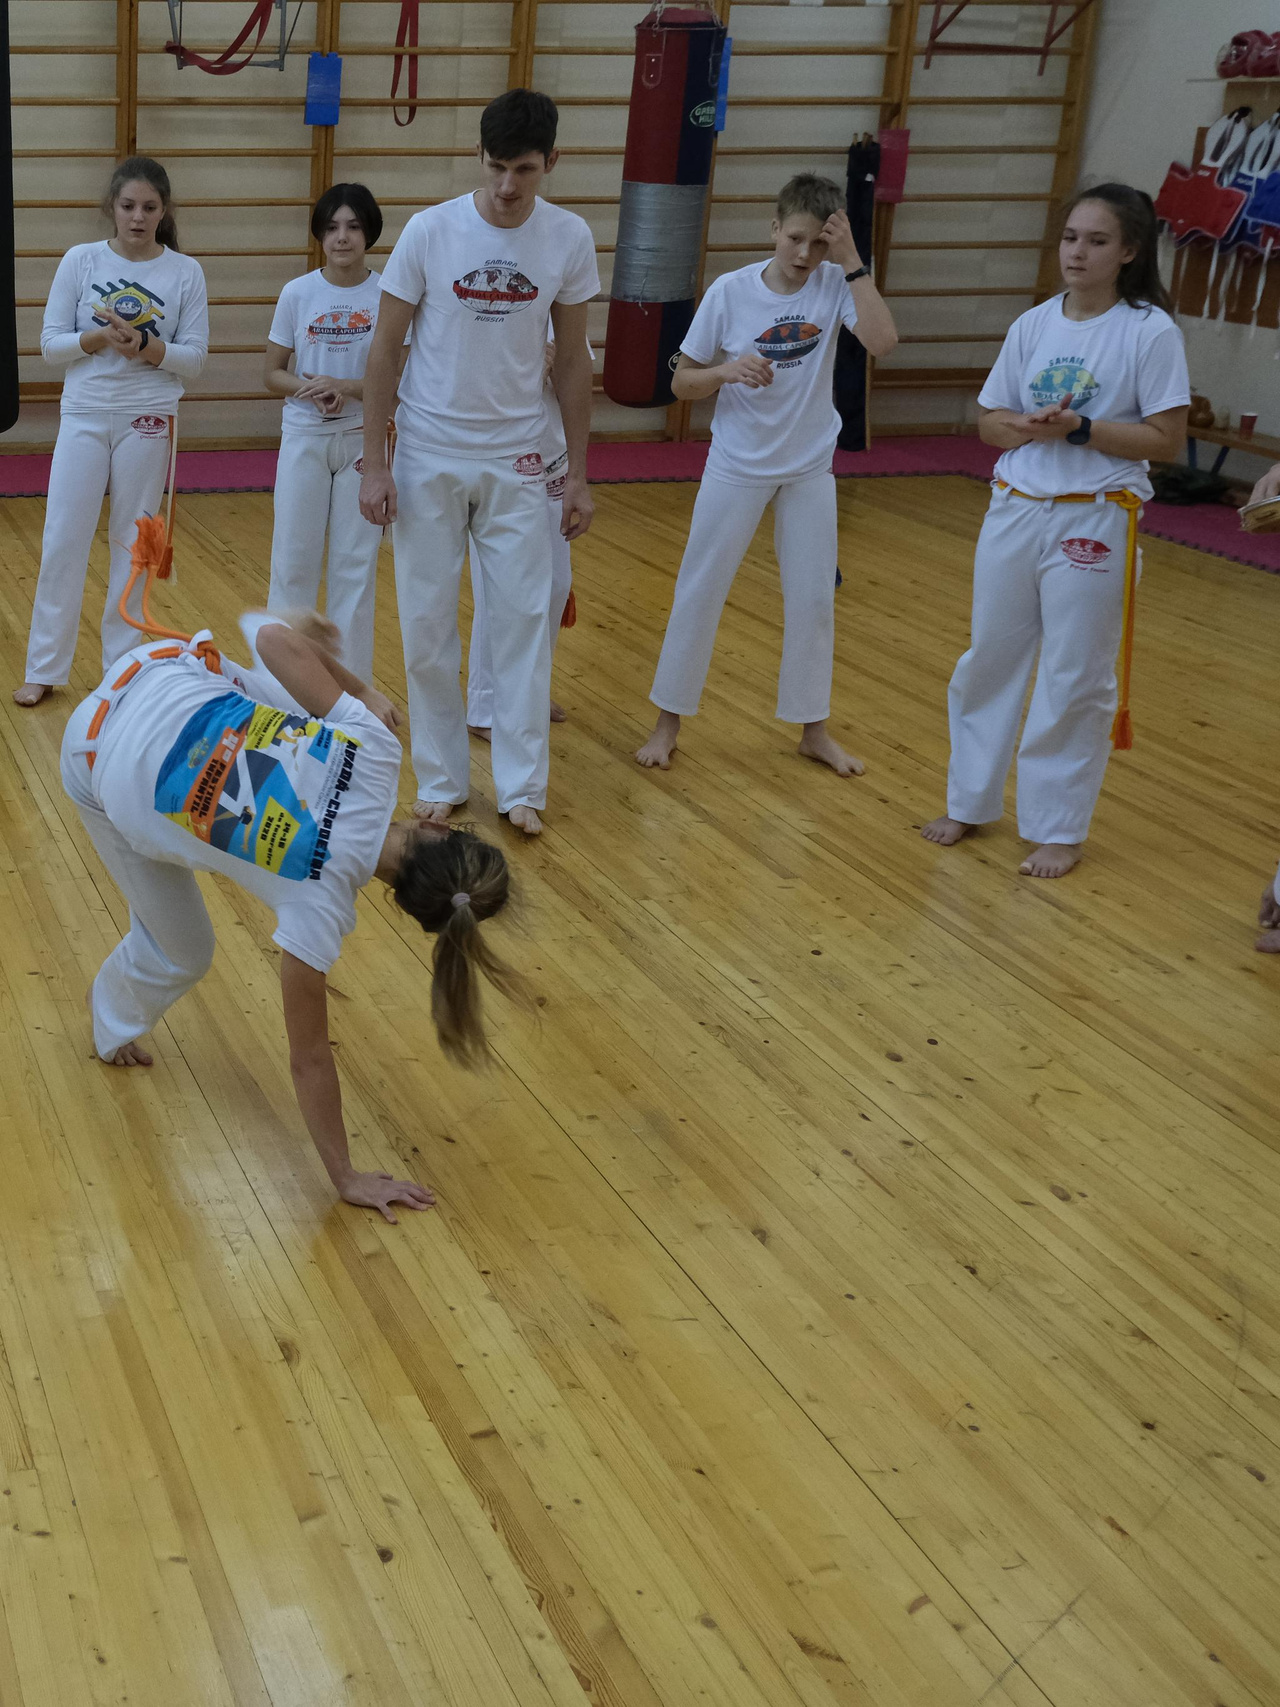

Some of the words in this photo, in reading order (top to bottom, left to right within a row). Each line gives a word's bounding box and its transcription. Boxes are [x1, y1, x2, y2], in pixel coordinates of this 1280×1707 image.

[484, 259, 518, 268] SAMARA
[475, 315, 505, 323] RUSSIA
[774, 314, 806, 324] SAMARA
[190, 758, 219, 813] INFANTIL
[199, 762, 226, 818] FESTIVAL
[309, 740, 358, 881] ABADÁ-CAPOEIRA
[260, 815, 274, 841] 2020
